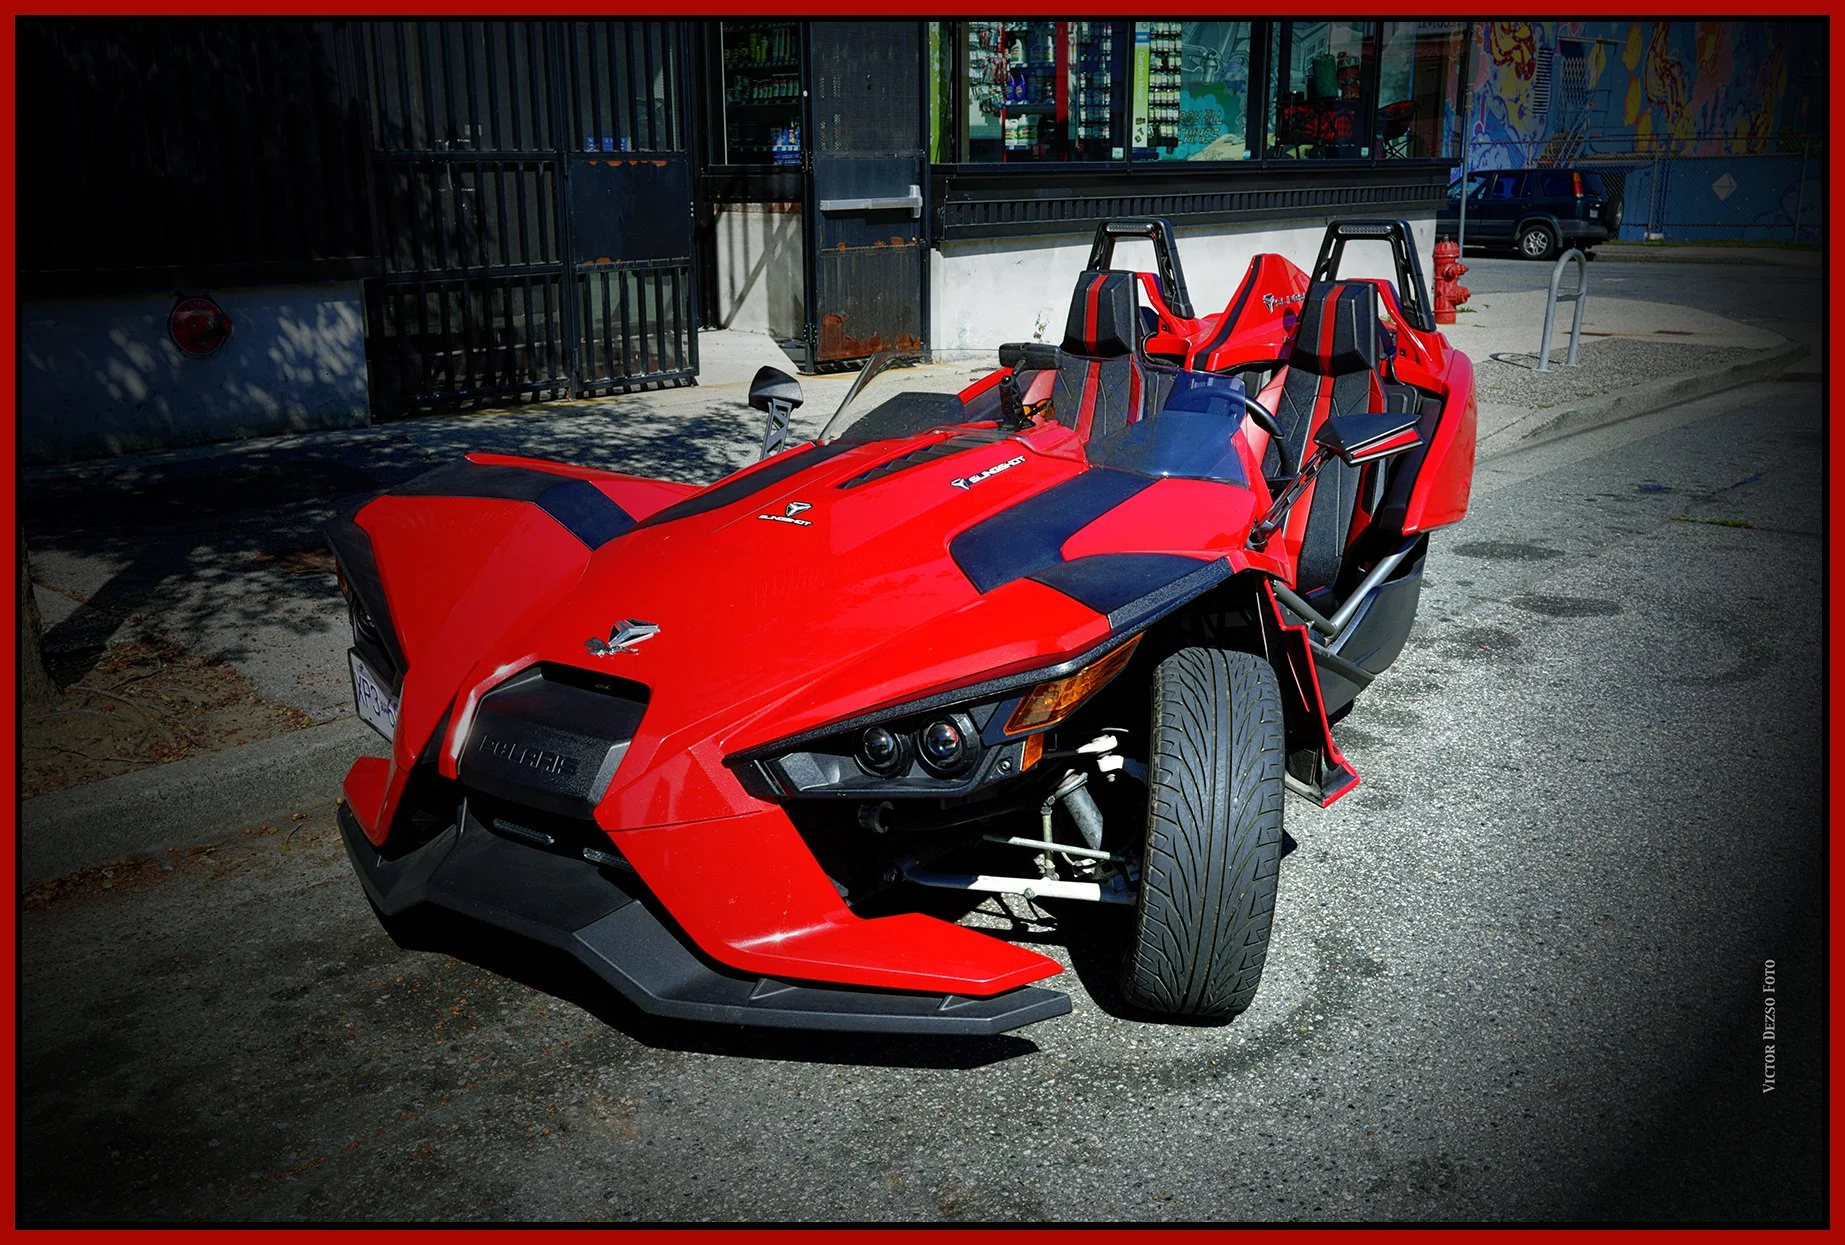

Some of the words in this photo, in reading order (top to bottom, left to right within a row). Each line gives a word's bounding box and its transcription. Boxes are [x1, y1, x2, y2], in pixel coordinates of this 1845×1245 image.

[968, 455, 1026, 484] SLINGSHOT
[758, 514, 812, 526] SLINGSHOT
[478, 735, 578, 776] POLARIS
